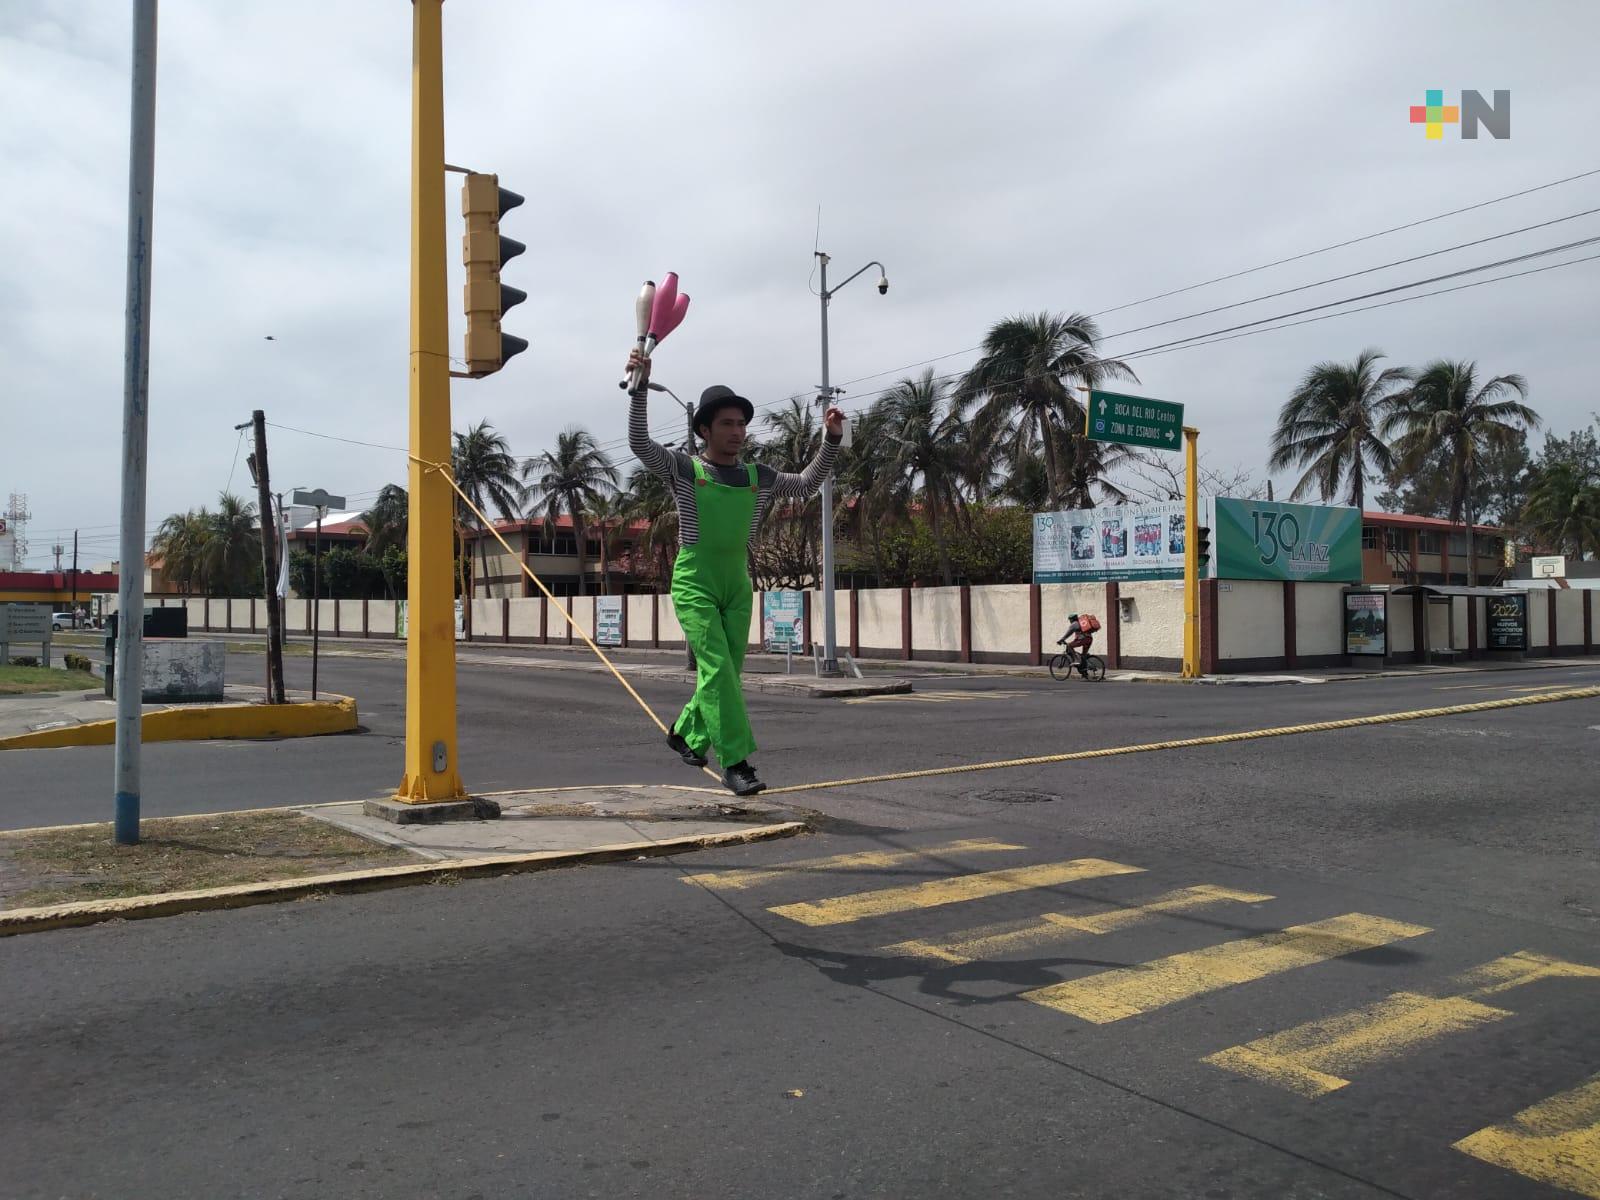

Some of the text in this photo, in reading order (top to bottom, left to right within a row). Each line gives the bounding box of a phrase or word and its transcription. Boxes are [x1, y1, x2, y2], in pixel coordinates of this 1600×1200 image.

[1114, 403, 1176, 423] BOCA DEL RIO Centro
[1110, 422, 1160, 439] ZONA DE ESTADIOS
[1037, 516, 1055, 532] 130
[1251, 510, 1300, 565] 130
[1291, 542, 1329, 561] LA PAZ
[1491, 603, 1522, 617] 2022
